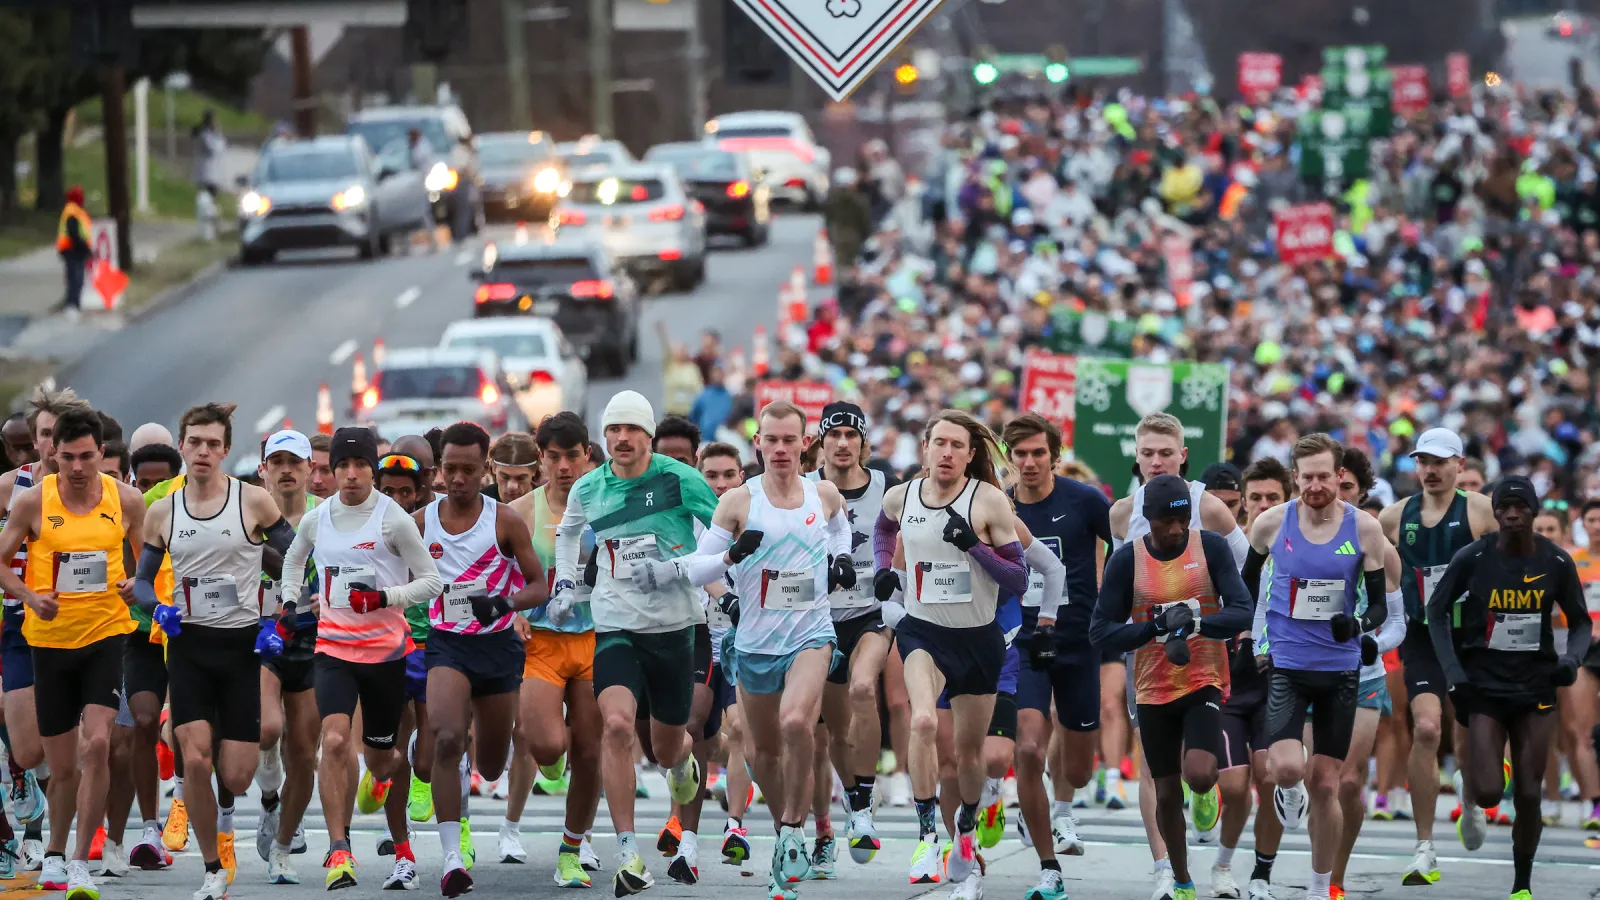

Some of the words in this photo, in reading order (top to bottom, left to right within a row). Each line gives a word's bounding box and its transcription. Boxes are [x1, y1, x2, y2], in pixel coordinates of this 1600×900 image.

[1169, 499, 1189, 509] HOKA
[907, 516, 926, 525] ZAP
[178, 530, 197, 539] ZAP
[622, 551, 646, 562] KLECKER
[73, 567, 91, 576] MAIER
[934, 578, 955, 586] COLLEY
[781, 586, 800, 594] YOUNG
[204, 592, 220, 600] FORD
[1307, 595, 1331, 603] FISCHER
[1488, 588, 1545, 609] ARMY
